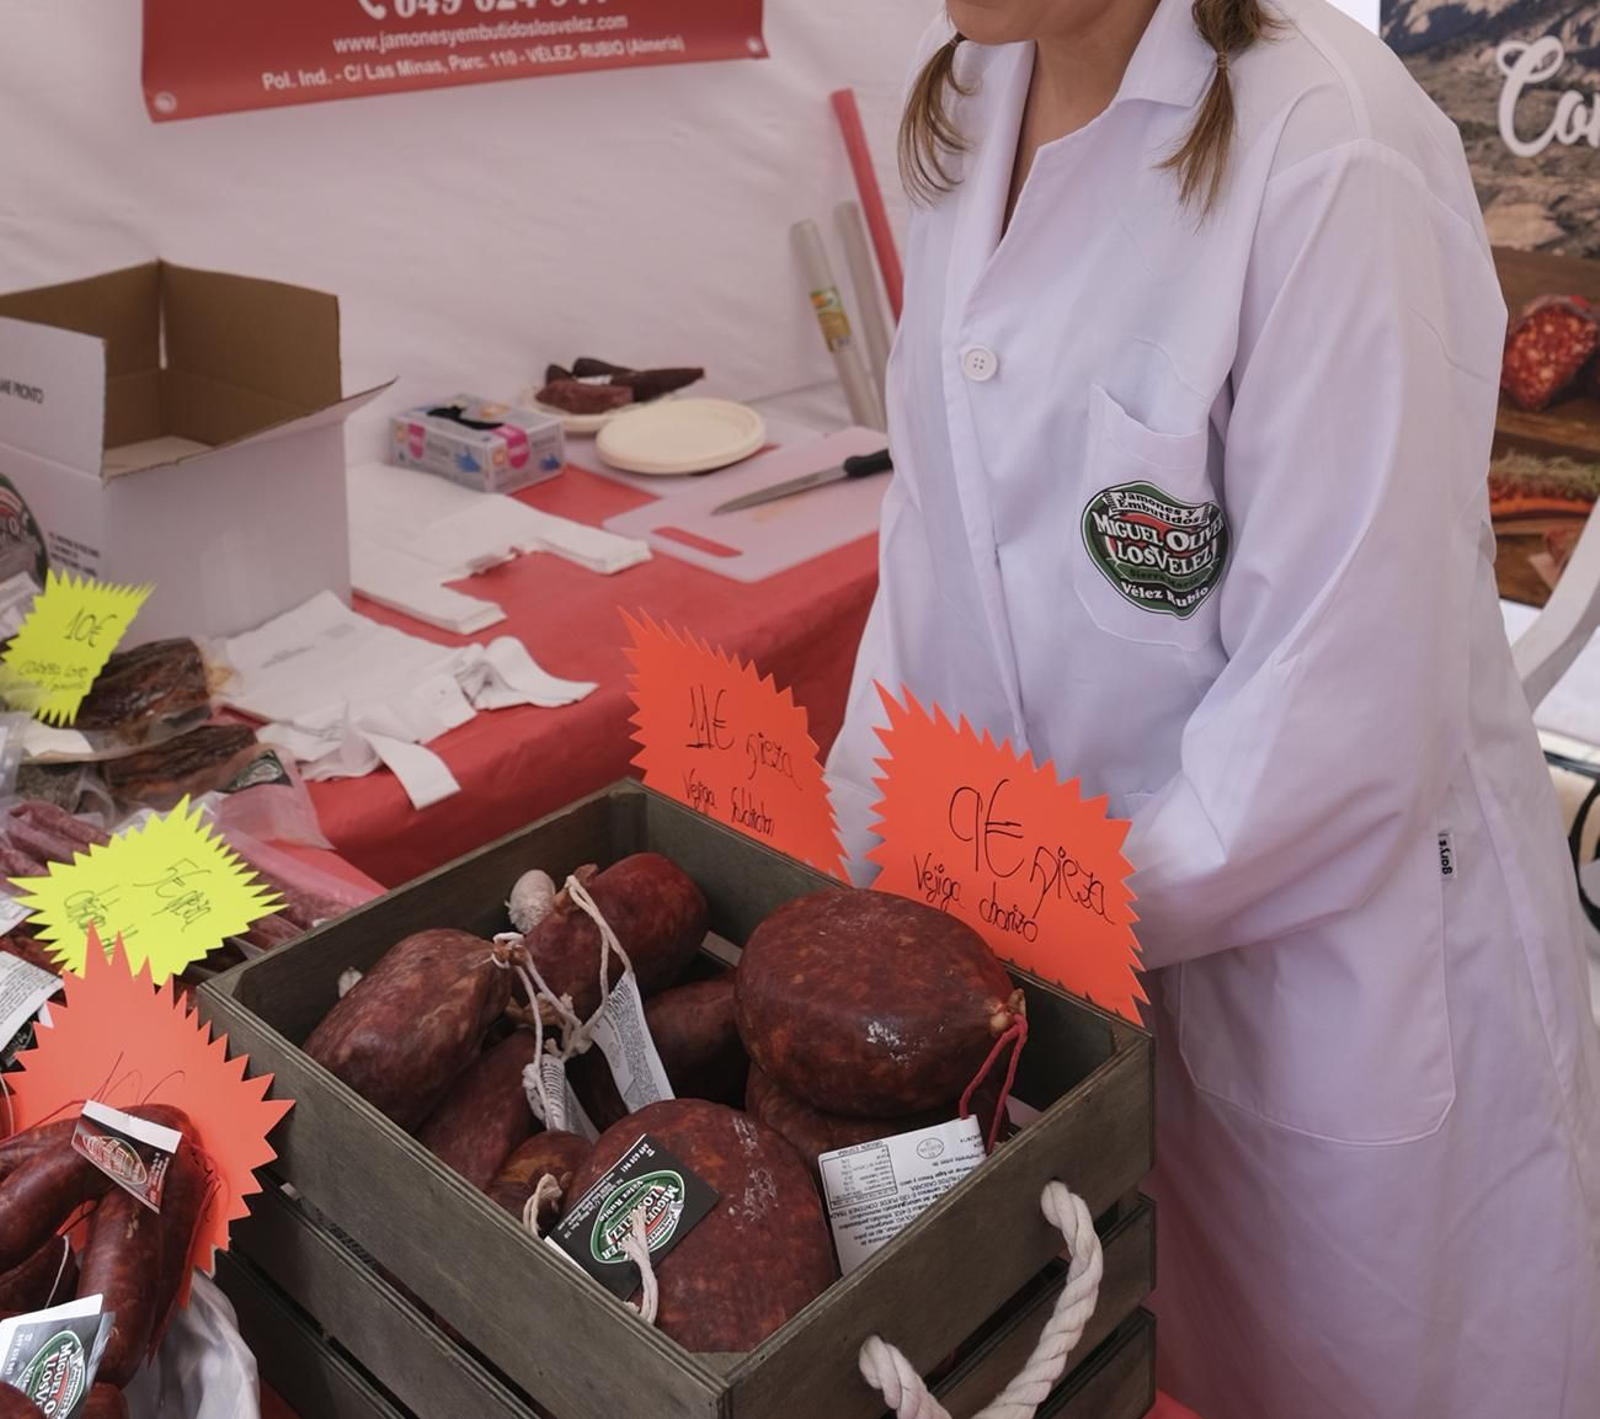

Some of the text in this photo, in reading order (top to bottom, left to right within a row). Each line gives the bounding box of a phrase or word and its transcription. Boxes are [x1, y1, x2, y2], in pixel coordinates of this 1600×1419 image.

[262, 71, 296, 90] Pol.
[299, 68, 332, 87] Ind.
[364, 63, 396, 80] Las
[490, 49, 518, 67] 110
[1117, 497, 1201, 525] Embutidos
[1121, 491, 1197, 518] Jamones y
[1091, 510, 1164, 546] MIGUEL
[1121, 580, 1209, 608] Vélez Rubio
[686, 683, 735, 751] 11€
[949, 778, 1025, 878] 9€
[913, 852, 966, 913] Vejiga
